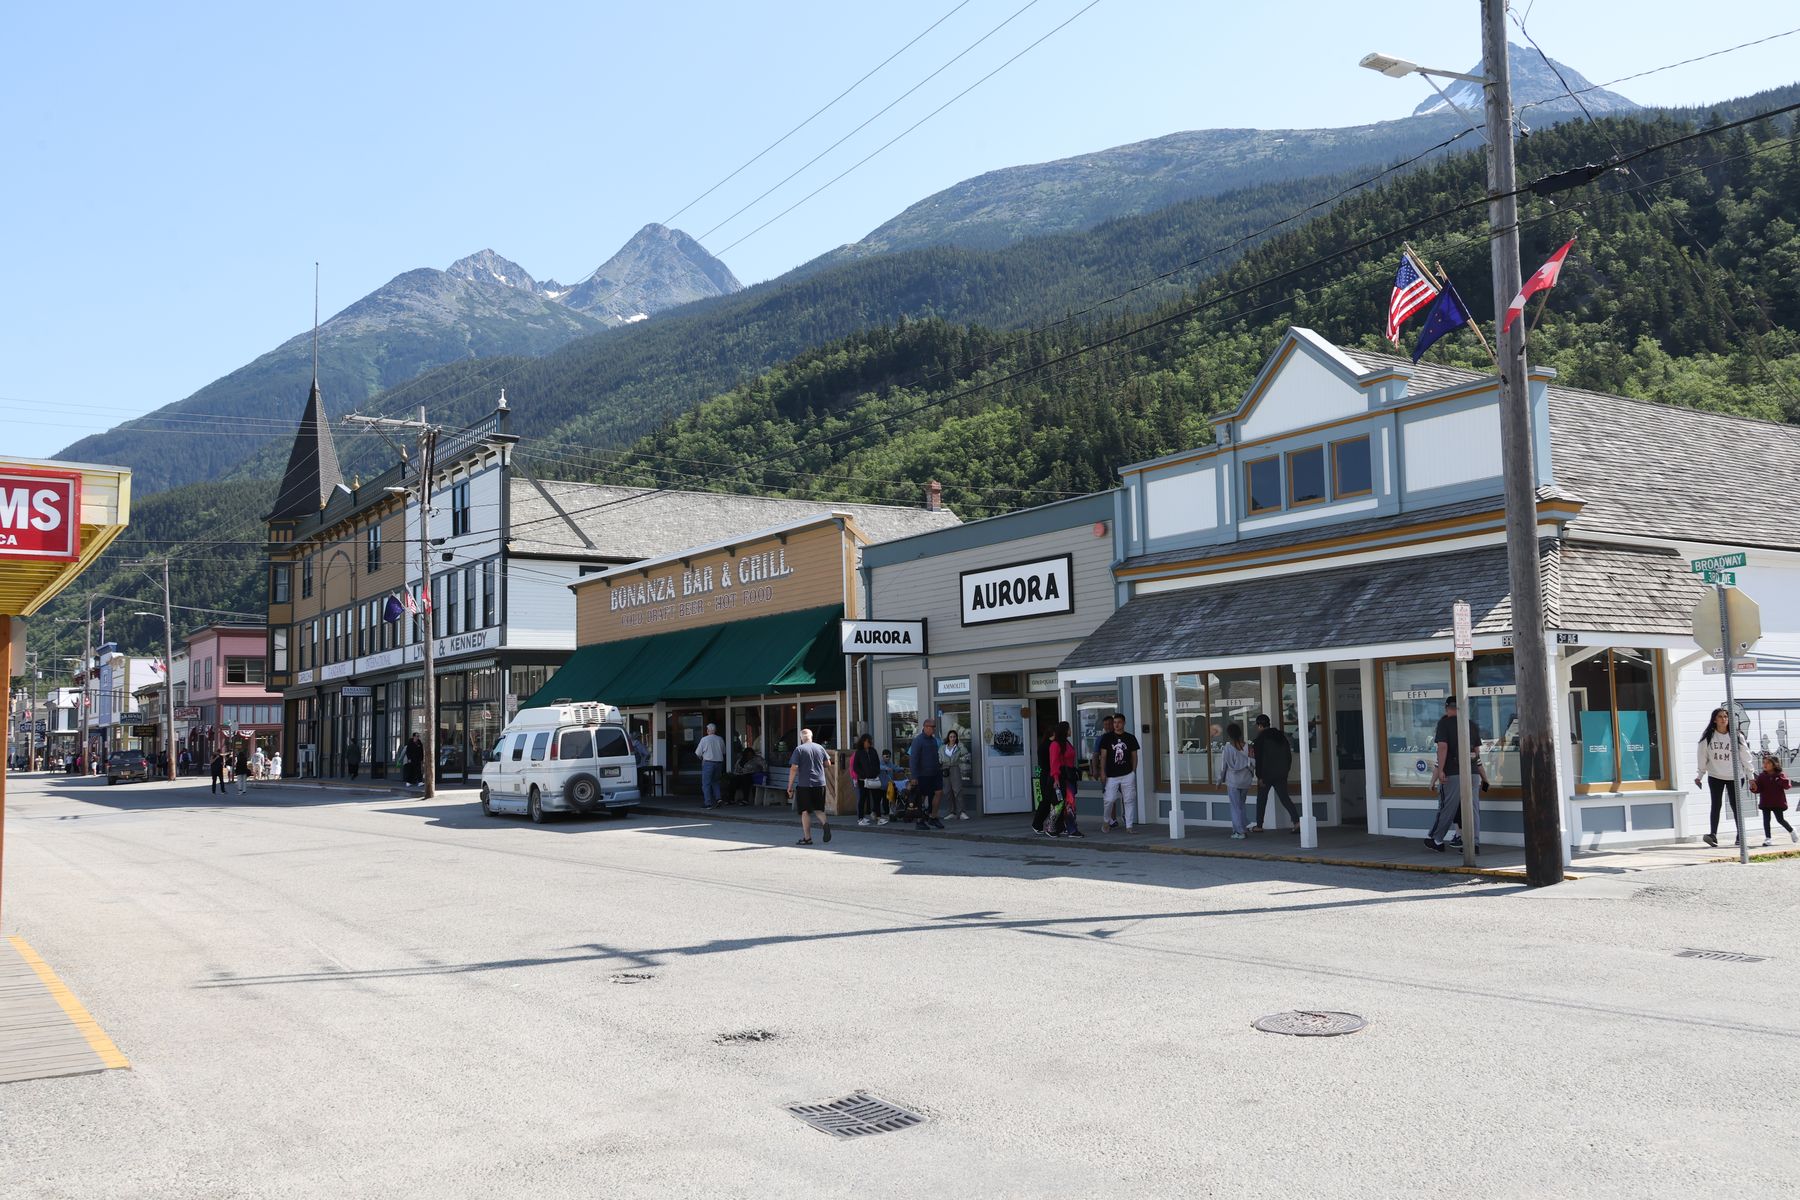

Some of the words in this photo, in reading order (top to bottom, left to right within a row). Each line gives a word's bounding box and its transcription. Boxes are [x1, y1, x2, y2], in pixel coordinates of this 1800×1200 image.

[1694, 555, 1742, 571] BROADWAY
[1721, 573, 1731, 584] AVE
[610, 575, 676, 611] BONANZA
[682, 565, 714, 597] BAR
[721, 561, 732, 588] &
[971, 572, 1060, 611] AURORA
[647, 604, 675, 623] DRAFT
[679, 598, 705, 617] BEER
[714, 591, 737, 611] HOT
[743, 586, 773, 606] FOOD
[439, 640, 446, 656] &
[450, 631, 487, 652] KENNEDY
[854, 630, 912, 644] AURORA
[1407, 691, 1428, 699] EFFY
[1482, 687, 1504, 695] EFFY
[1710, 742, 1732, 751] TEXA
[1714, 753, 1730, 761] A&M
